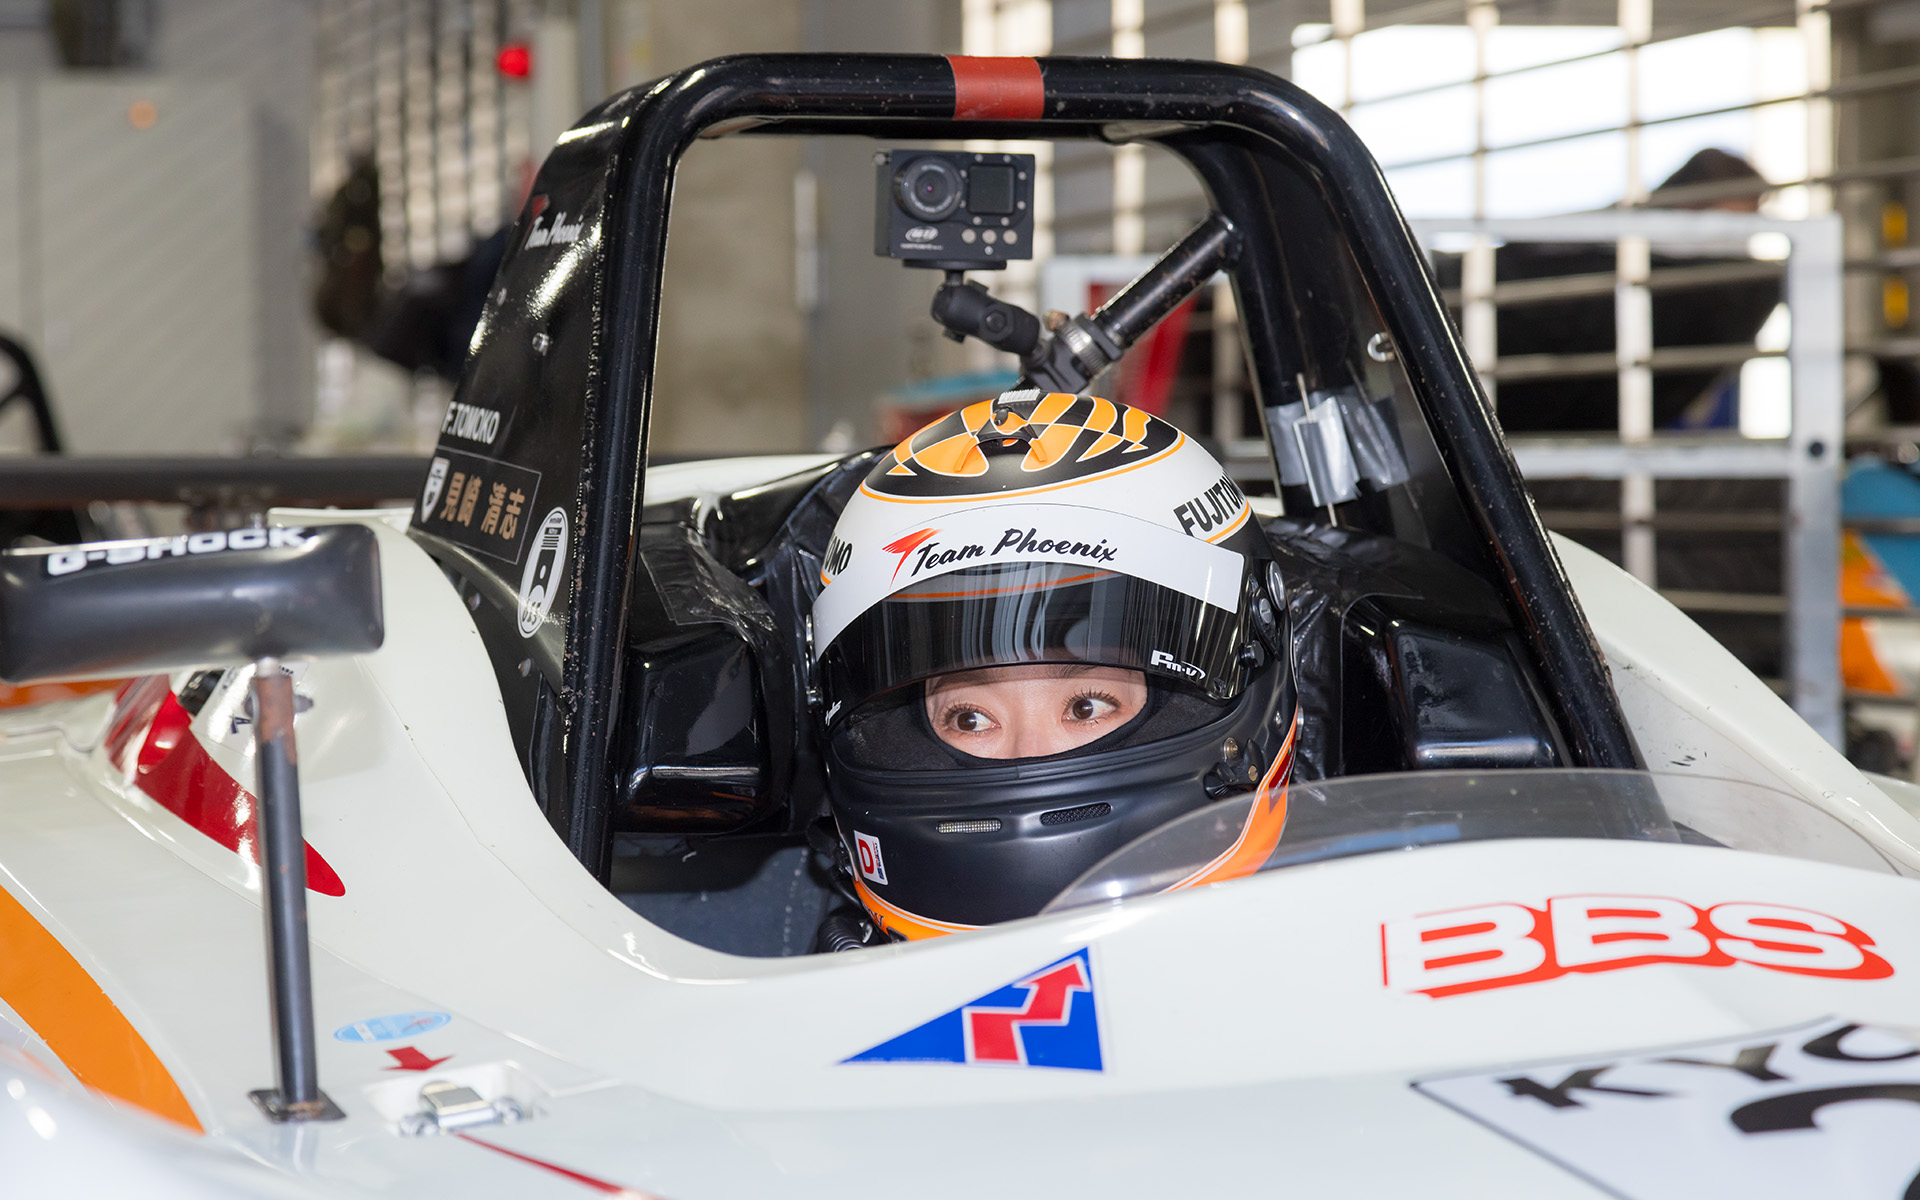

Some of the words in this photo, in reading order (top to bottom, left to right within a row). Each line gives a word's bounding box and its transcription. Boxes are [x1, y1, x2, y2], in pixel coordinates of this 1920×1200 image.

[441, 400, 501, 445] F.TOMOKO
[480, 481, 526, 540] 清志
[1173, 468, 1246, 537] FUJITOM
[47, 526, 308, 576] G-SHOCK
[911, 541, 986, 577] Team
[990, 527, 1118, 563] Phoenix
[1381, 893, 1895, 999] BBS
